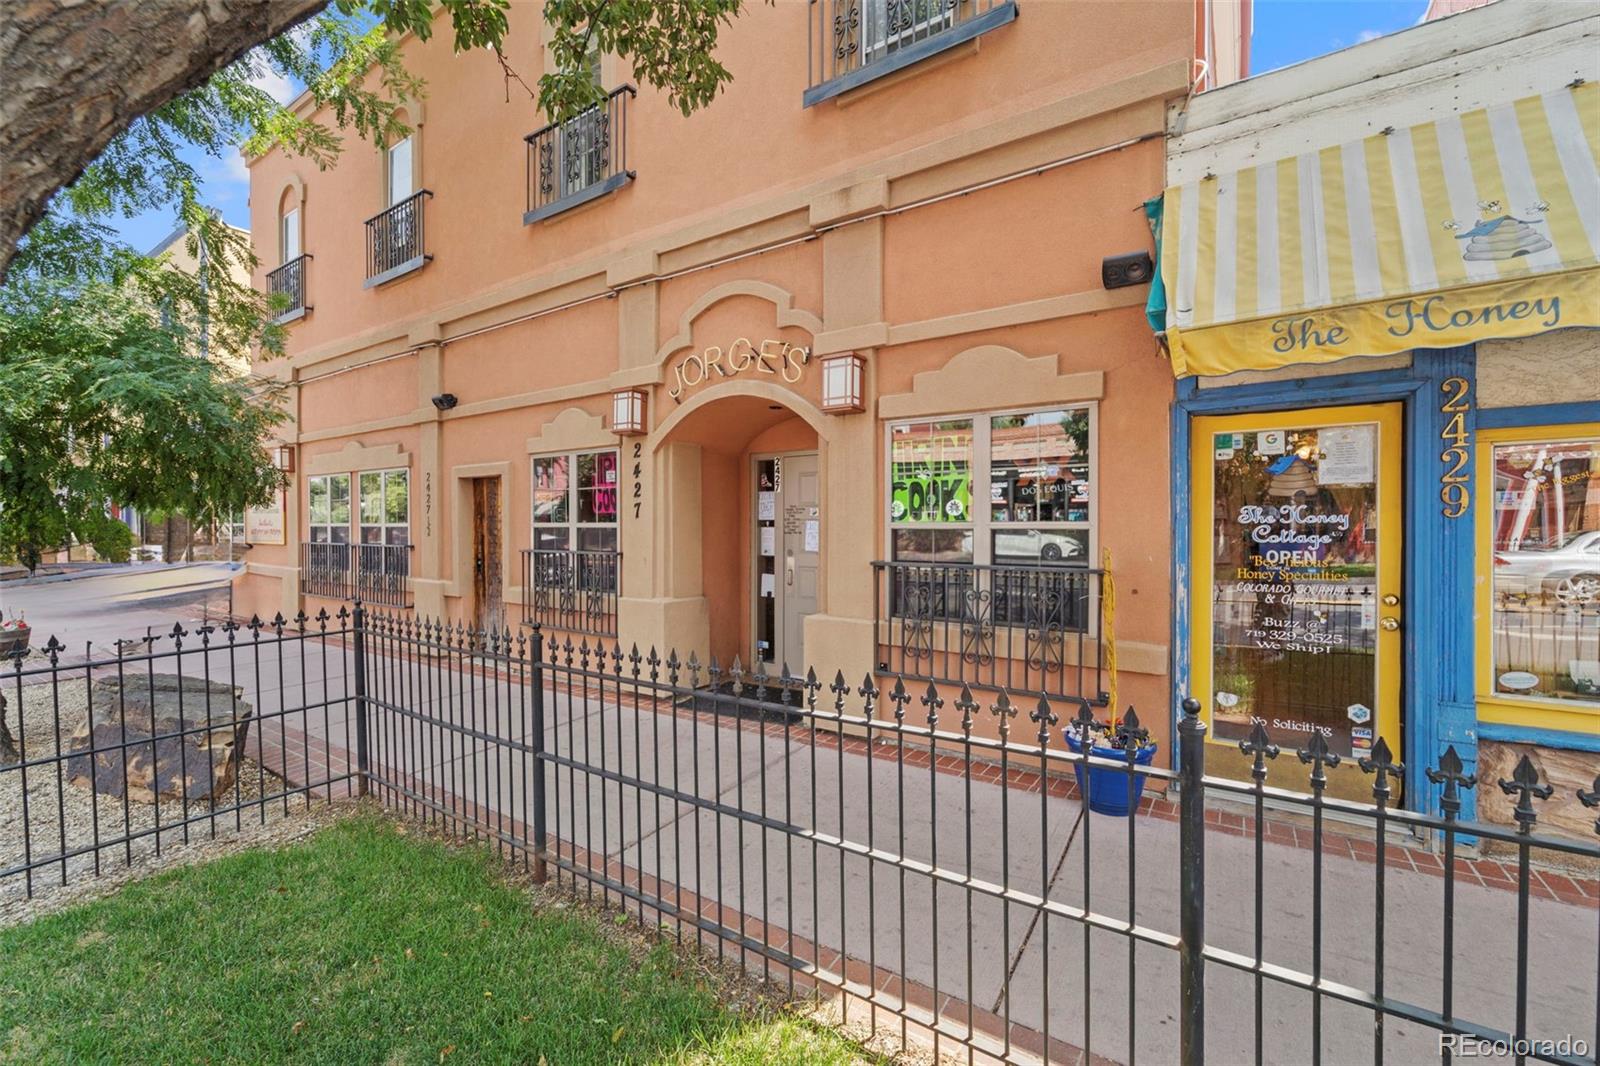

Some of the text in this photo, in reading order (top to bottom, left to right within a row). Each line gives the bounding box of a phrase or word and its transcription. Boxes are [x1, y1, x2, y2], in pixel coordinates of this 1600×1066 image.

[1271, 295, 1561, 353] The Honey
[669, 338, 806, 397] JORGE'S
[1441, 377, 1470, 518] 2429
[633, 442, 642, 519] 2427
[1044, 483, 1074, 495] EQUIS
[1237, 505, 1349, 530] The Honey
[1252, 525, 1332, 550] Cottage
[1266, 550, 1317, 564] OPEN
[1237, 568, 1348, 582] Honey Specialties
[1236, 582, 1291, 594] COLORADO
[1265, 594, 1276, 604] &
[1264, 617, 1321, 630] Buzz @
[1245, 629, 1344, 644] 719 329-0525
[1256, 640, 1331, 655] We Ship!
[1250, 716, 1333, 737] No Soliciting
[1354, 729, 1371, 737] VISA
